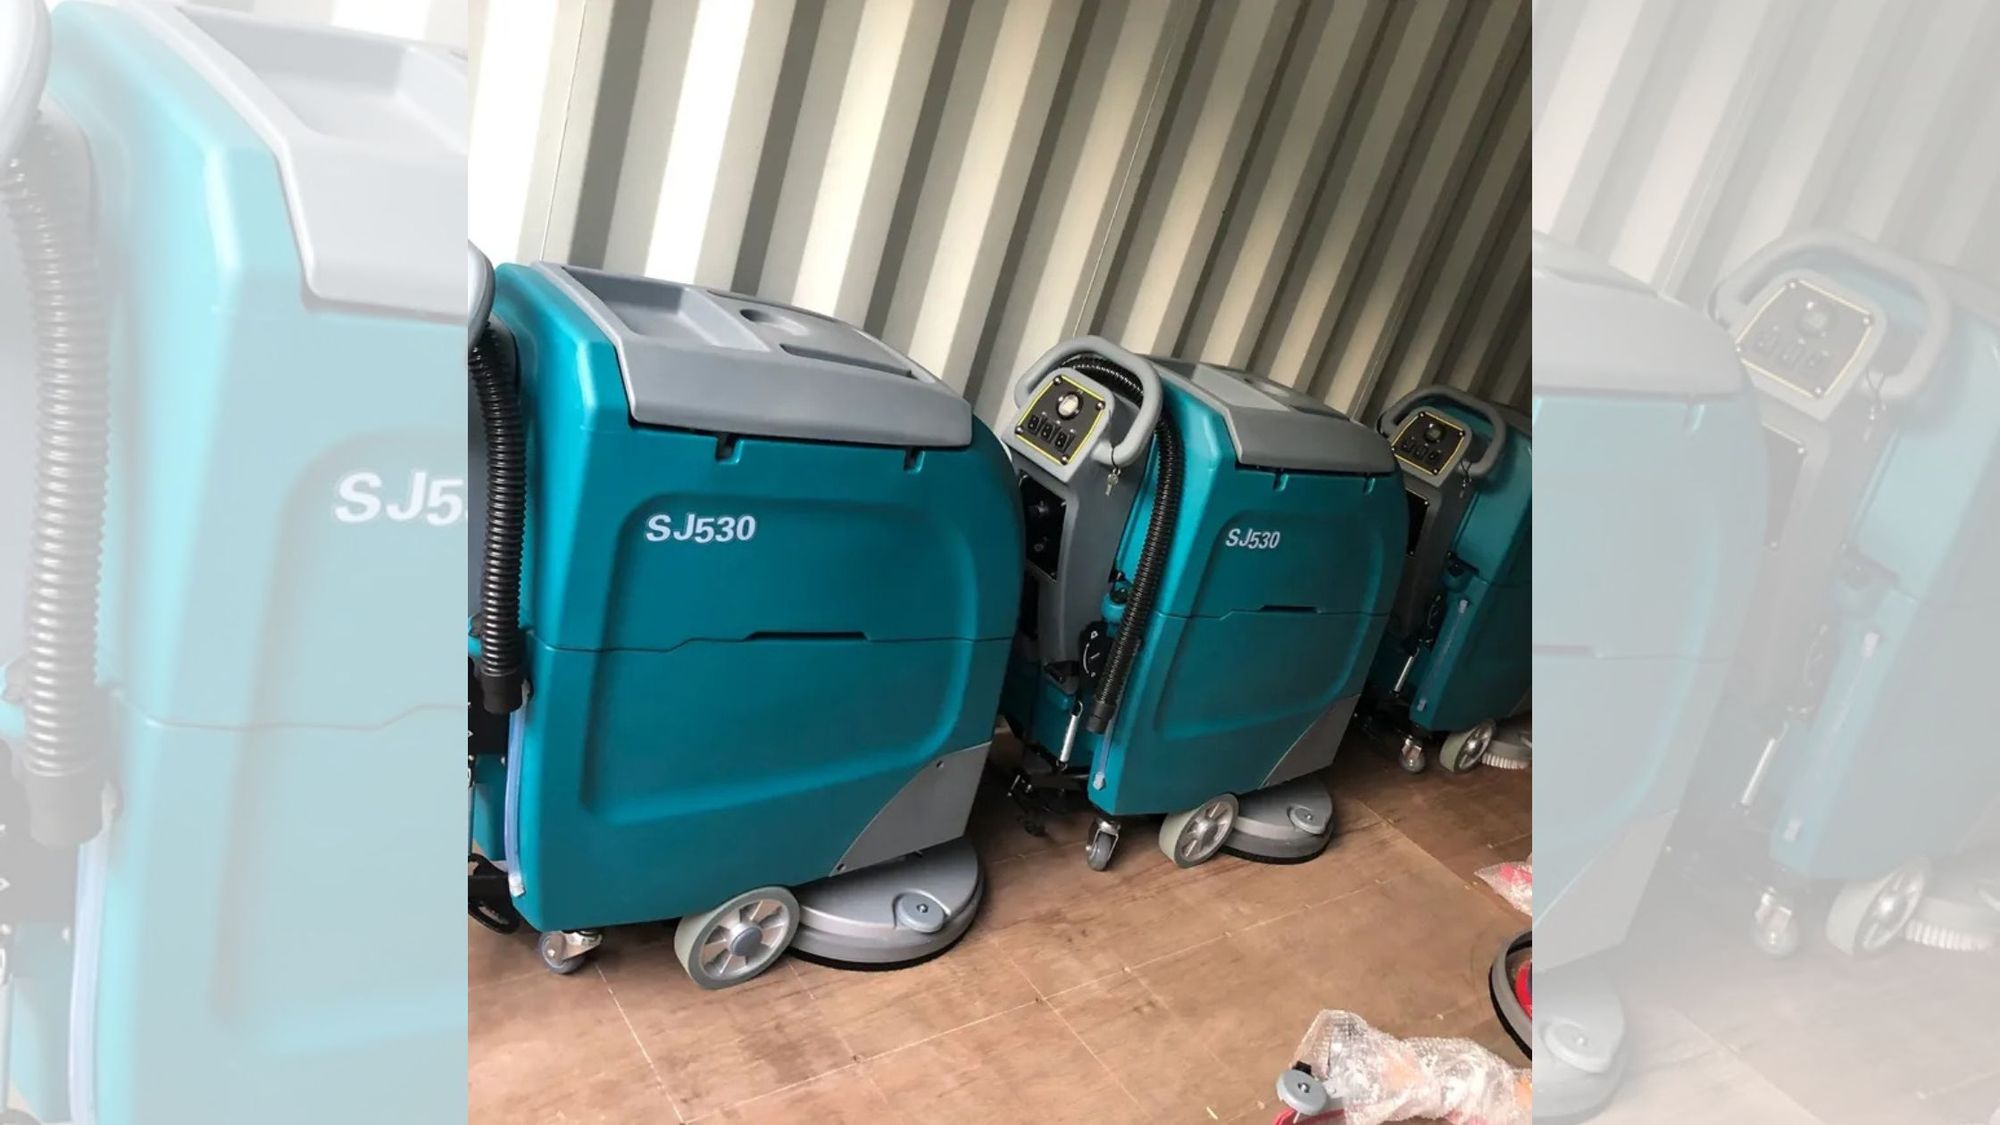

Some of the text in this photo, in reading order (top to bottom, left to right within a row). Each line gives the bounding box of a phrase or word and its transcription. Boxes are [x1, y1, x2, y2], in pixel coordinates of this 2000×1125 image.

[334, 471, 468, 526] SJ5
[645, 513, 756, 544] SJ530
[1225, 528, 1280, 549] SJ530
